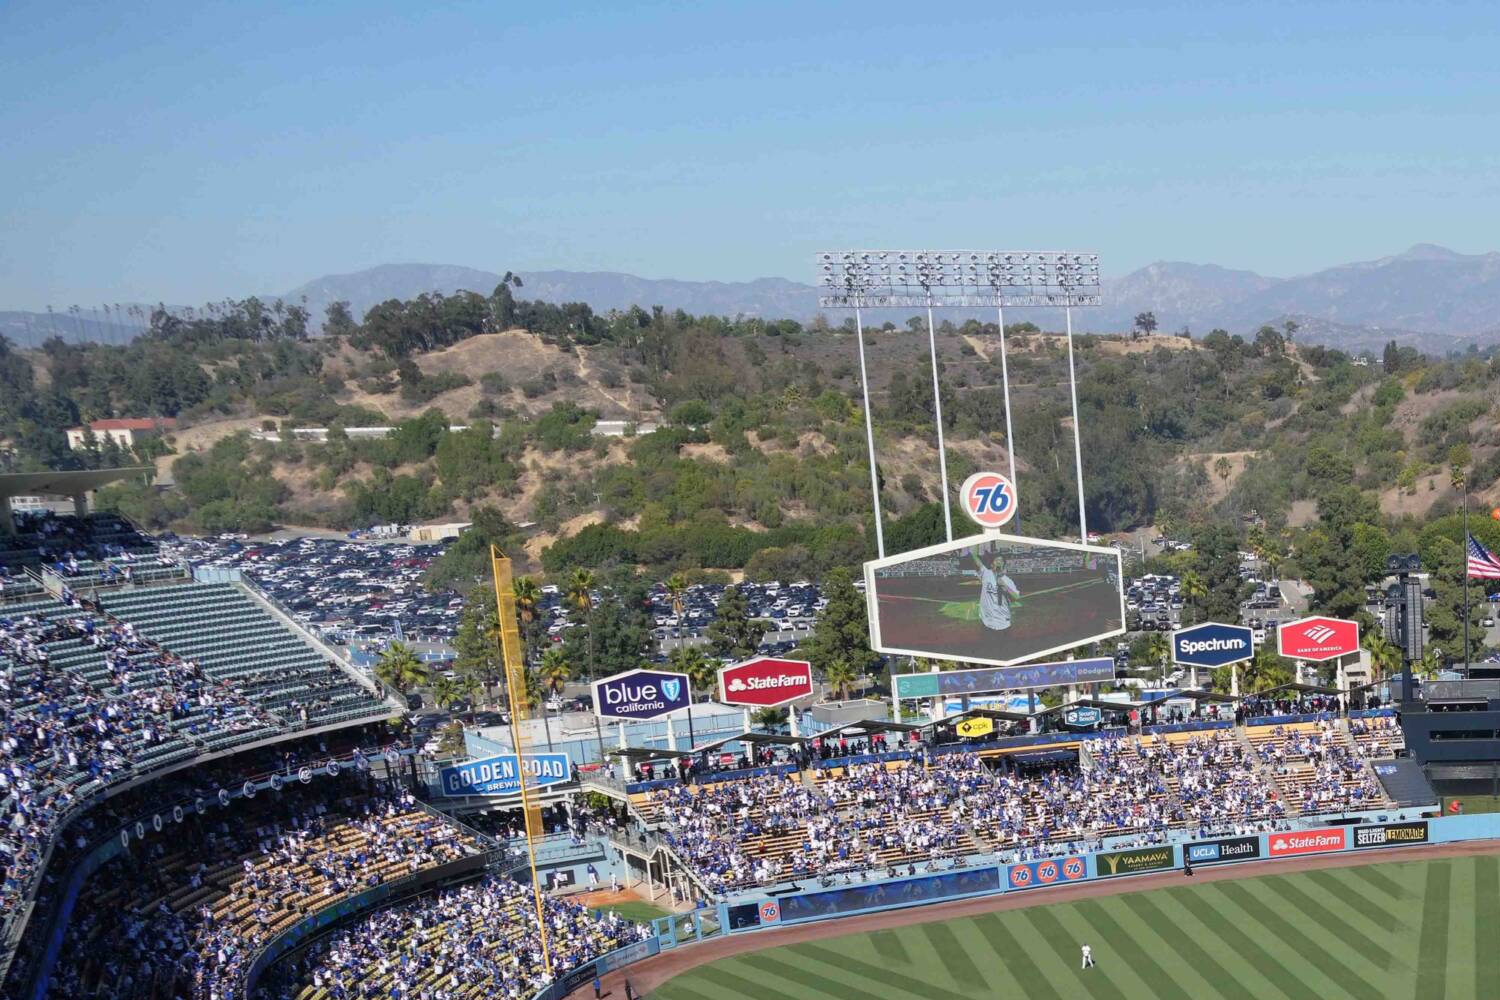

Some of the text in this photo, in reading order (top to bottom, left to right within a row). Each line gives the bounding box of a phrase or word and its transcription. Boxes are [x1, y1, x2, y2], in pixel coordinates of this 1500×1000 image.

[973, 482, 1011, 514] 76
[1179, 637, 1244, 655] Spectrum
[746, 674, 807, 691] StateFarm
[605, 682, 657, 704] blue
[615, 700, 664, 713] california
[973, 720, 989, 731] cpk
[449, 759, 563, 792] GOLDEN ROAD
[487, 779, 530, 792] BREWING
[1357, 831, 1386, 844] SELTZER
[1386, 827, 1425, 840] LEMONADE
[1288, 835, 1341, 849] StateFarm
[1193, 843, 1254, 857] UCLA Health
[1015, 869, 1030, 881] 76
[1042, 865, 1055, 877] 76
[1067, 863, 1082, 874] 76
[763, 905, 778, 917] 76
